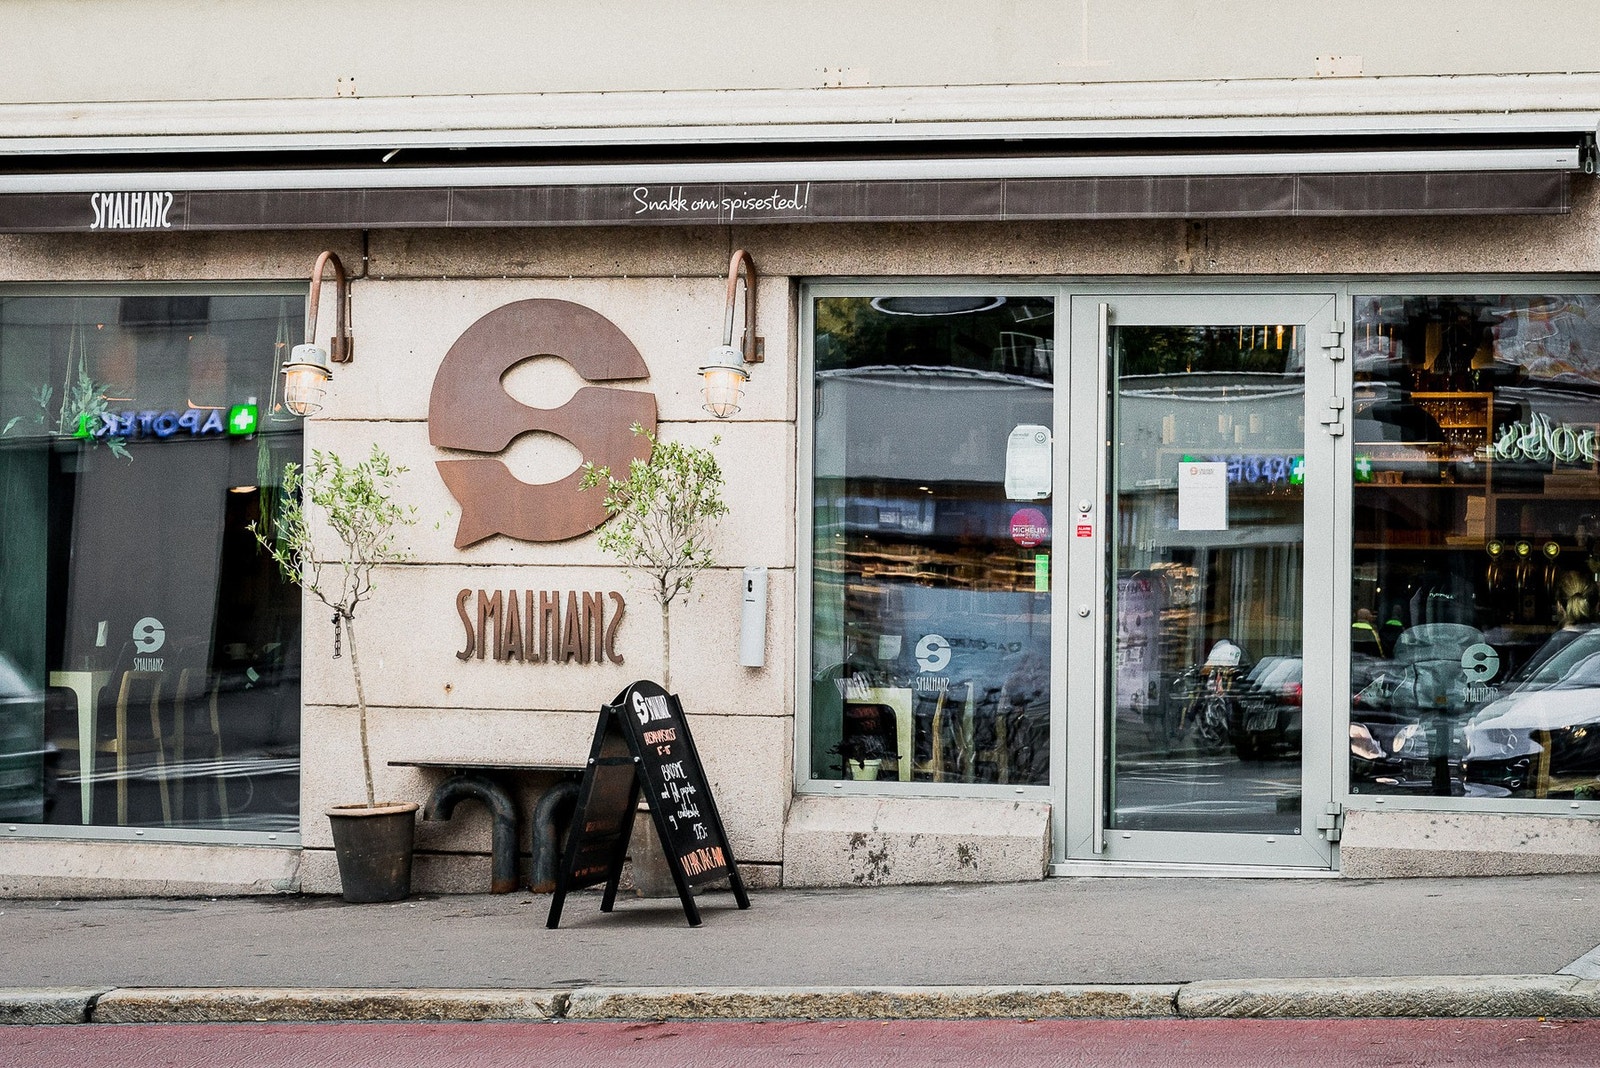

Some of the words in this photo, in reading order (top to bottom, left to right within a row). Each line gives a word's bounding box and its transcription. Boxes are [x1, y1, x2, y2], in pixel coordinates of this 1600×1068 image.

[90, 191, 174, 229] SMALHANS
[633, 186, 689, 214] Snakk
[690, 198, 719, 211] om
[721, 182, 811, 221] spisested!
[455, 587, 625, 665] SMALHANS
[133, 657, 164, 672] SMALHANS
[915, 676, 950, 692] SMALHANS
